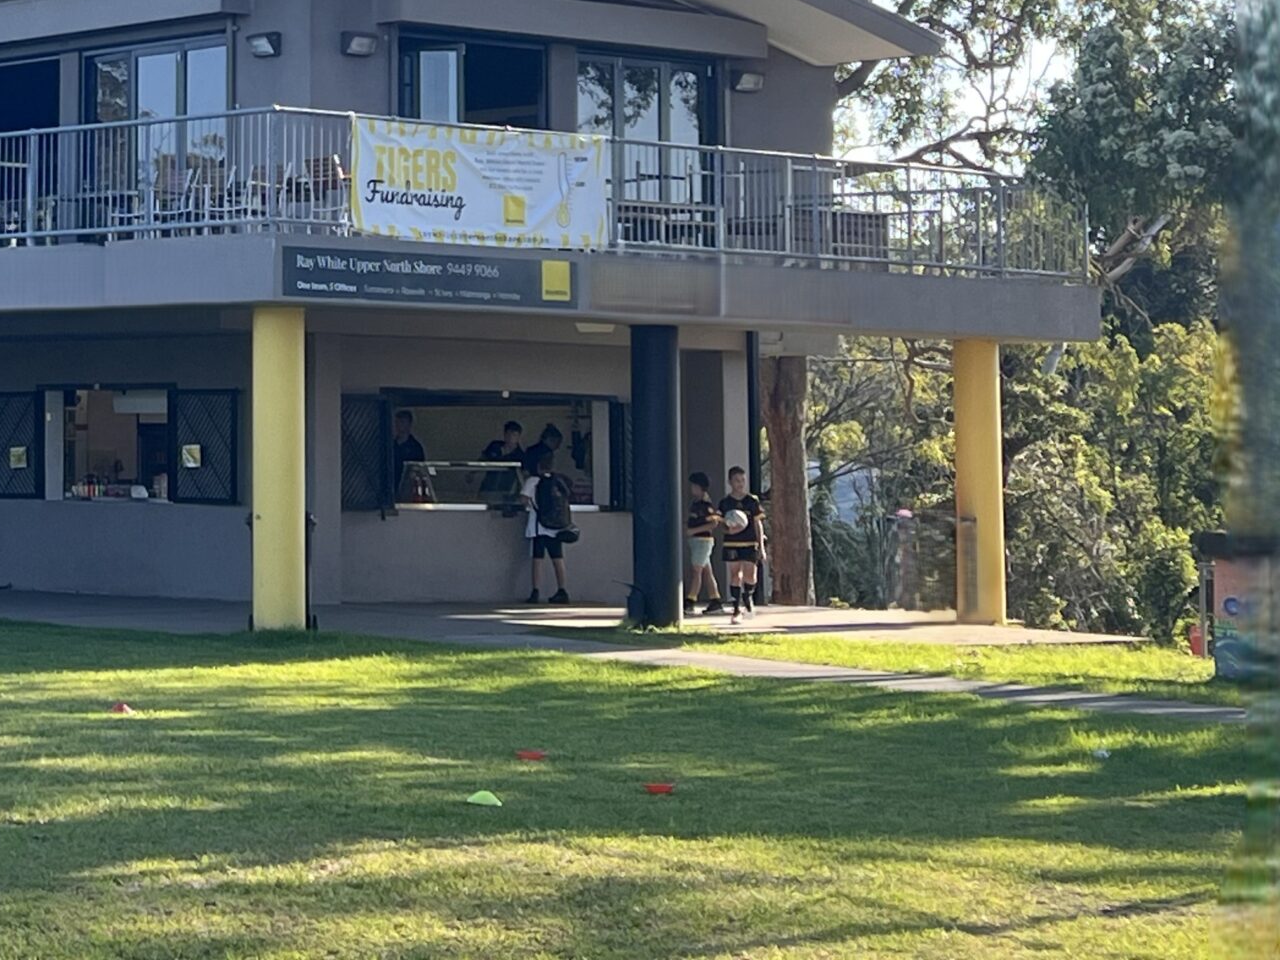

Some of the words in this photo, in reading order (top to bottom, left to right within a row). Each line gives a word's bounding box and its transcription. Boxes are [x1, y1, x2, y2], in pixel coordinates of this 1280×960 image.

[374, 145, 456, 193] TIGERS
[365, 179, 466, 221] Fundraising
[296, 254, 314, 271] Ray
[317, 255, 347, 271] White
[349, 258, 381, 274] Upper
[383, 259, 412, 273] North
[412, 260, 443, 275] Shore
